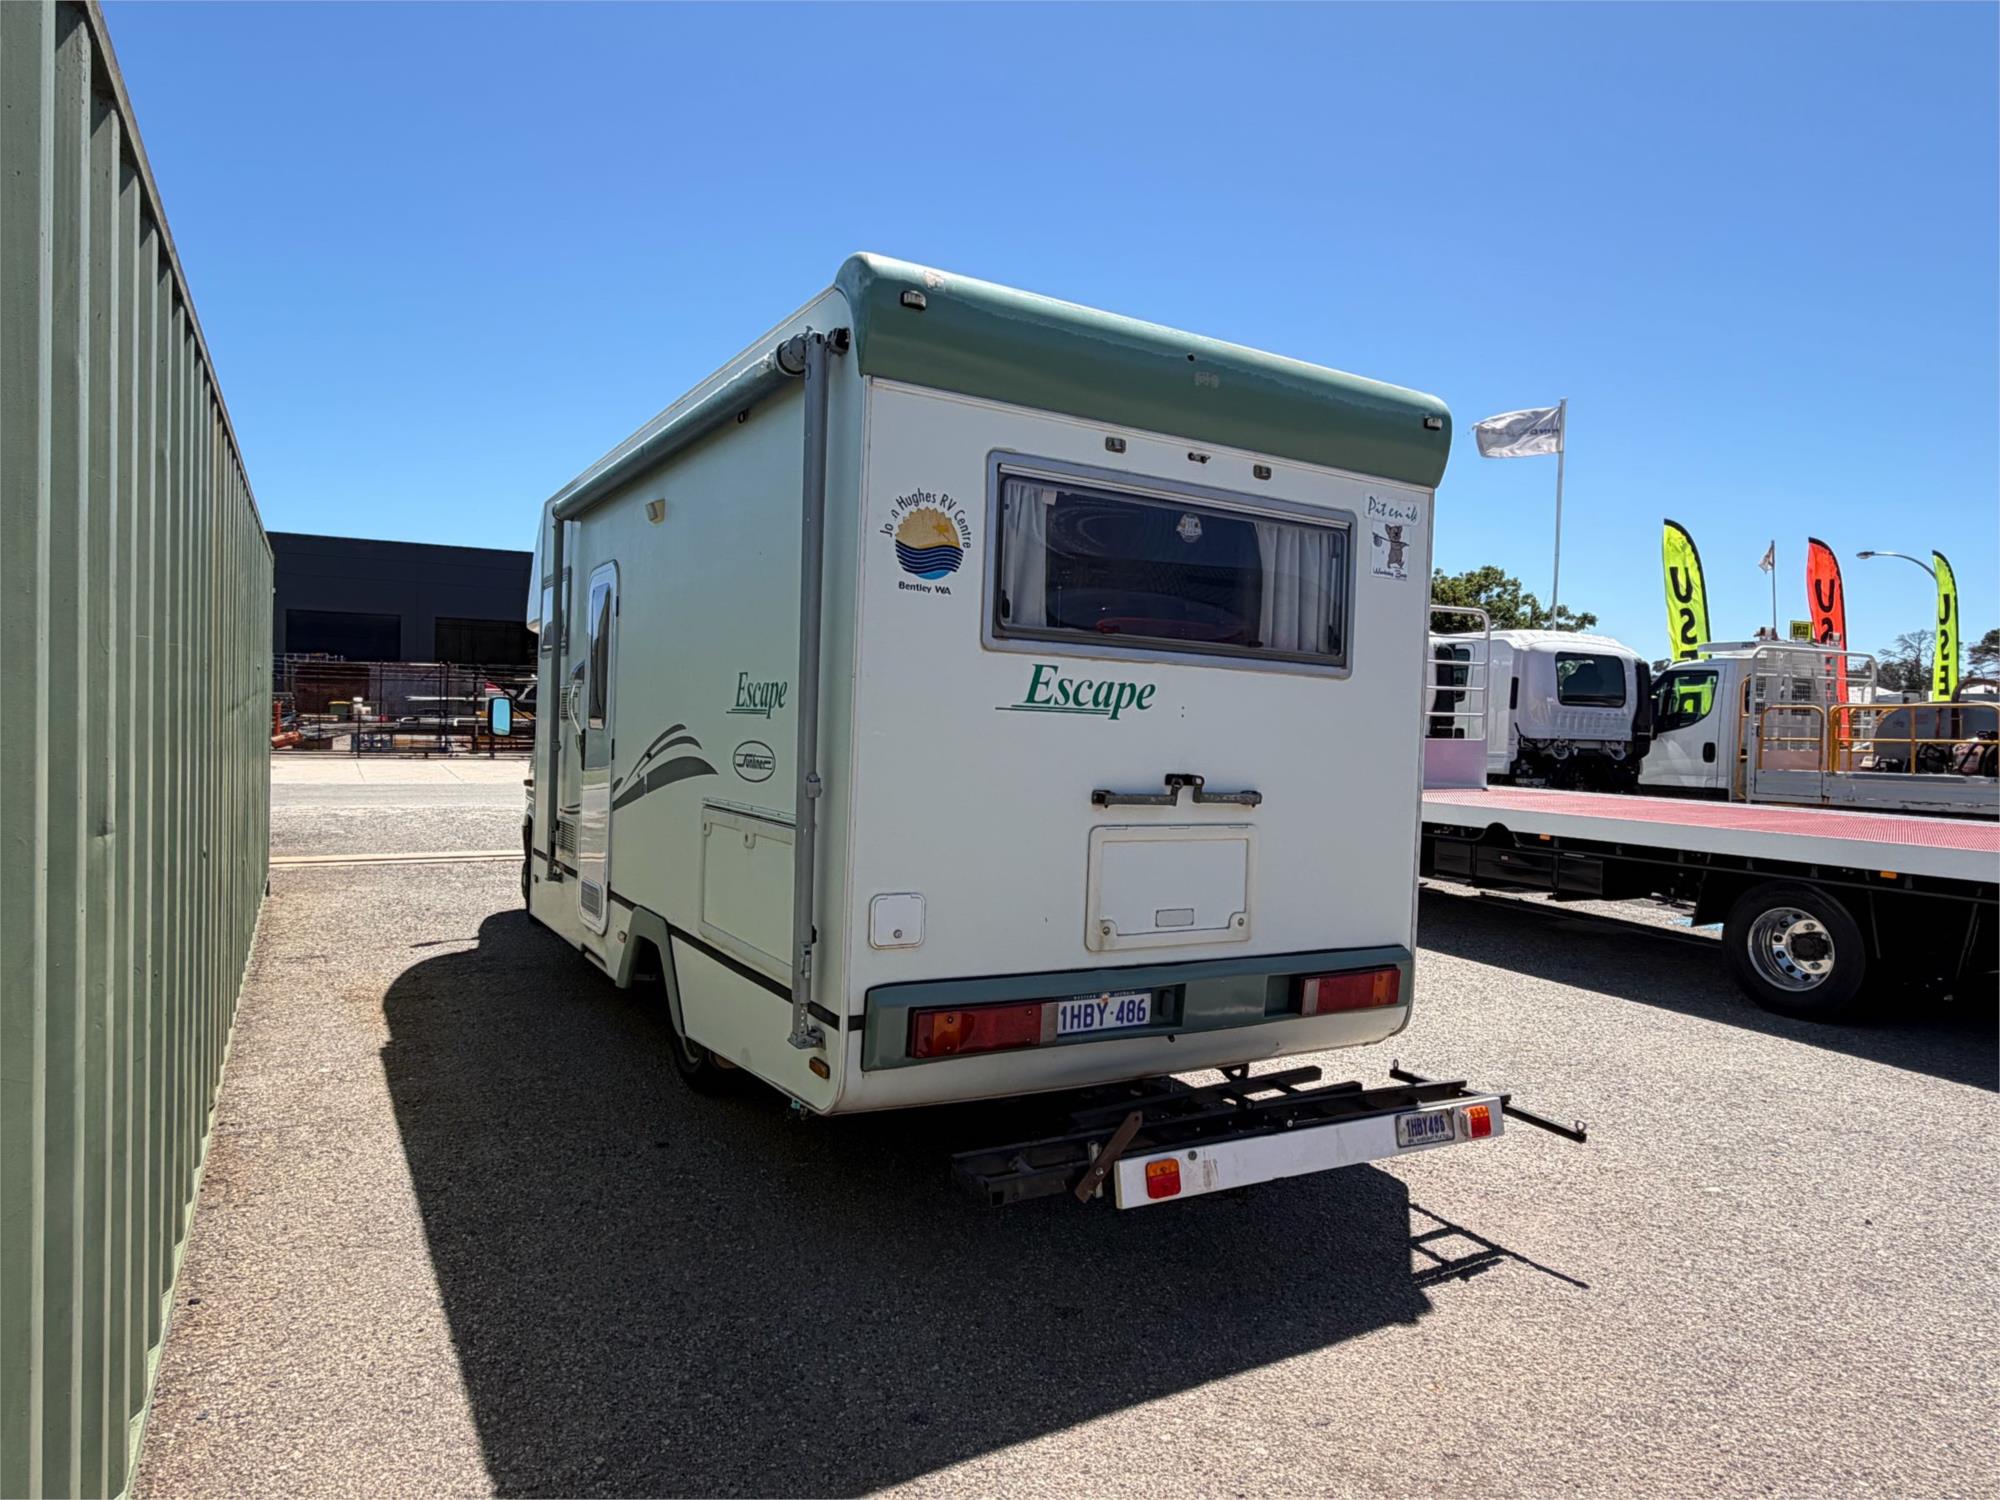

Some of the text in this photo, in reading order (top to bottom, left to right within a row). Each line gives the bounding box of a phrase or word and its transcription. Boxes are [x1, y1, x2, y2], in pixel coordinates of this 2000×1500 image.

[880, 488, 971, 549] Jon Hughes RV Centre
[935, 585, 952, 596] WA
[735, 672, 788, 719] Escape
[1023, 664, 1156, 720] Escape
